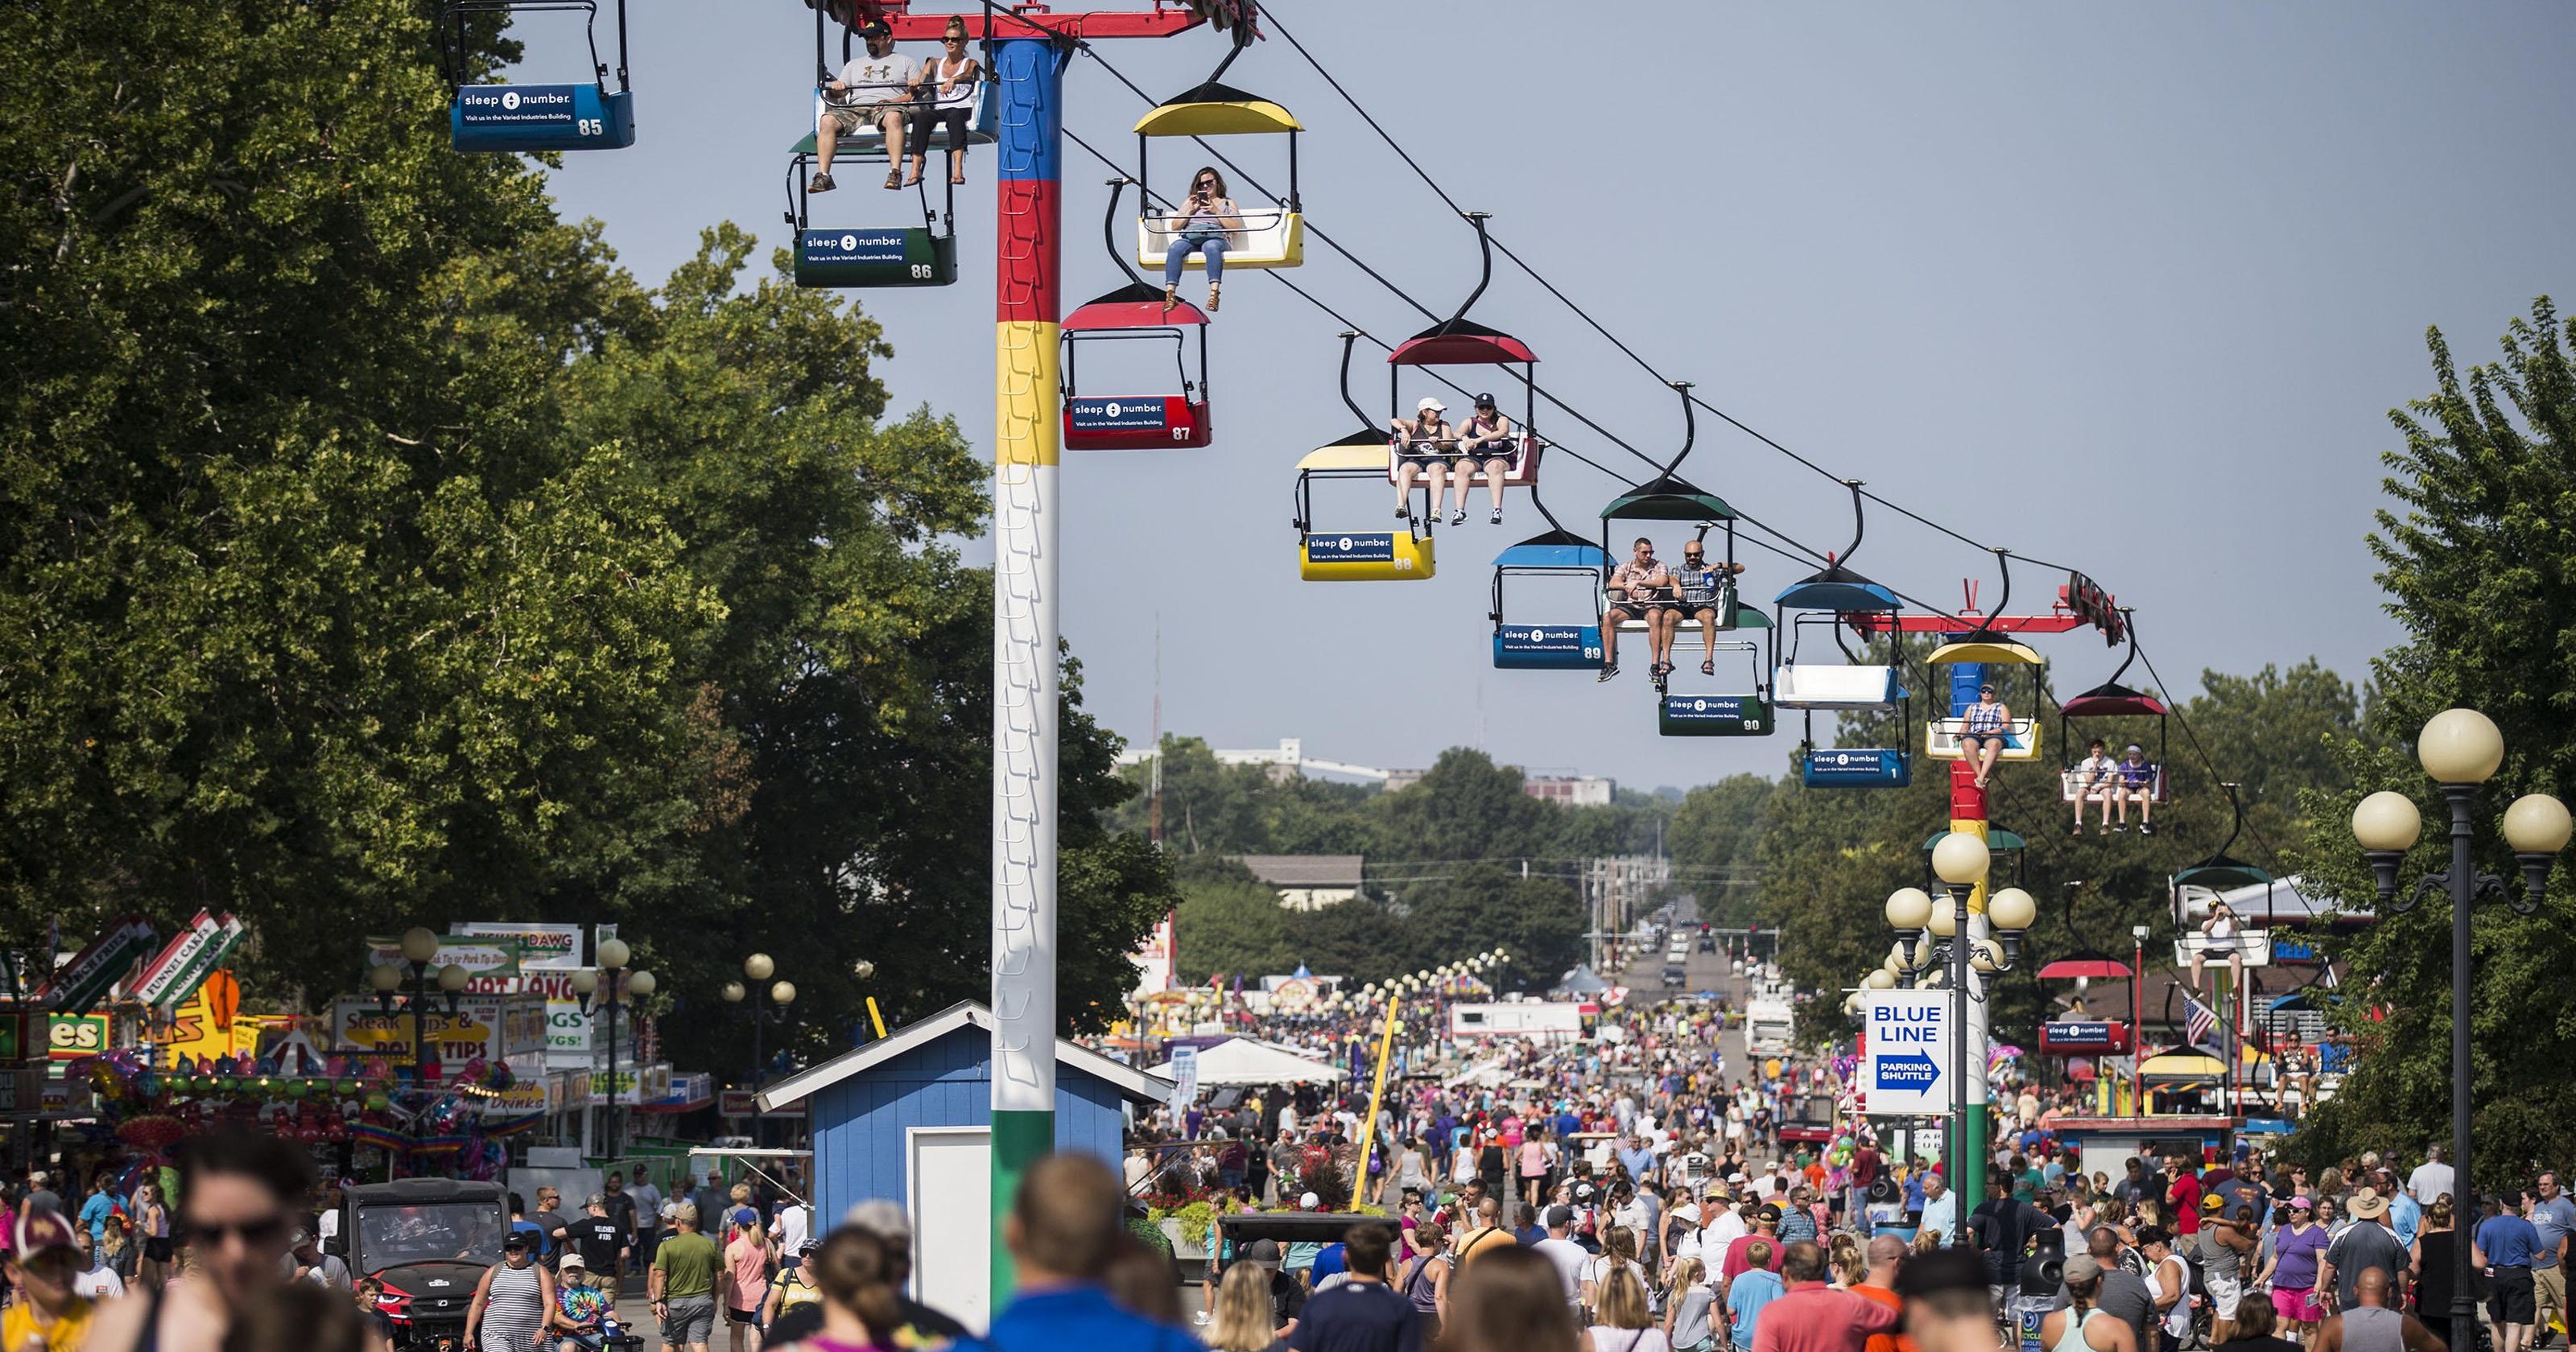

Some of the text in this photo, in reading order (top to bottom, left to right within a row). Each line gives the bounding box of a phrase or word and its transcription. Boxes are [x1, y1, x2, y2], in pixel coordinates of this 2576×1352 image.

[465, 95, 499, 107] sleep
[578, 119, 603, 136] 85
[808, 238, 837, 248] sleep
[911, 264, 932, 278] 86
[1075, 405, 1103, 415] sleep
[1172, 427, 1190, 440] 87
[1311, 539, 1337, 548] sleep
[1395, 558, 1412, 570] 88
[1505, 631, 1528, 640] sleep
[1584, 648, 1601, 659] 89
[1744, 720, 1759, 730] 90
[1891, 768, 1896, 778] 1
[529, 934, 573, 946] DAWG
[54, 932, 128, 1000] FRENCH FRIES
[147, 957, 183, 995] FUNNEL
[181, 928, 209, 958] CAKES
[347, 1013, 400, 1029] Steak
[458, 1011, 473, 1029] &
[1875, 1007, 1941, 1021] BLUE
[1881, 1027, 1937, 1042] LINE
[444, 1042, 487, 1059] TIPS
[1881, 1063, 1932, 1071] PARKING
[1881, 1072, 1932, 1080] SHUTTLE
[511, 1078, 536, 1091] old
[491, 1096, 545, 1109] Drinks
